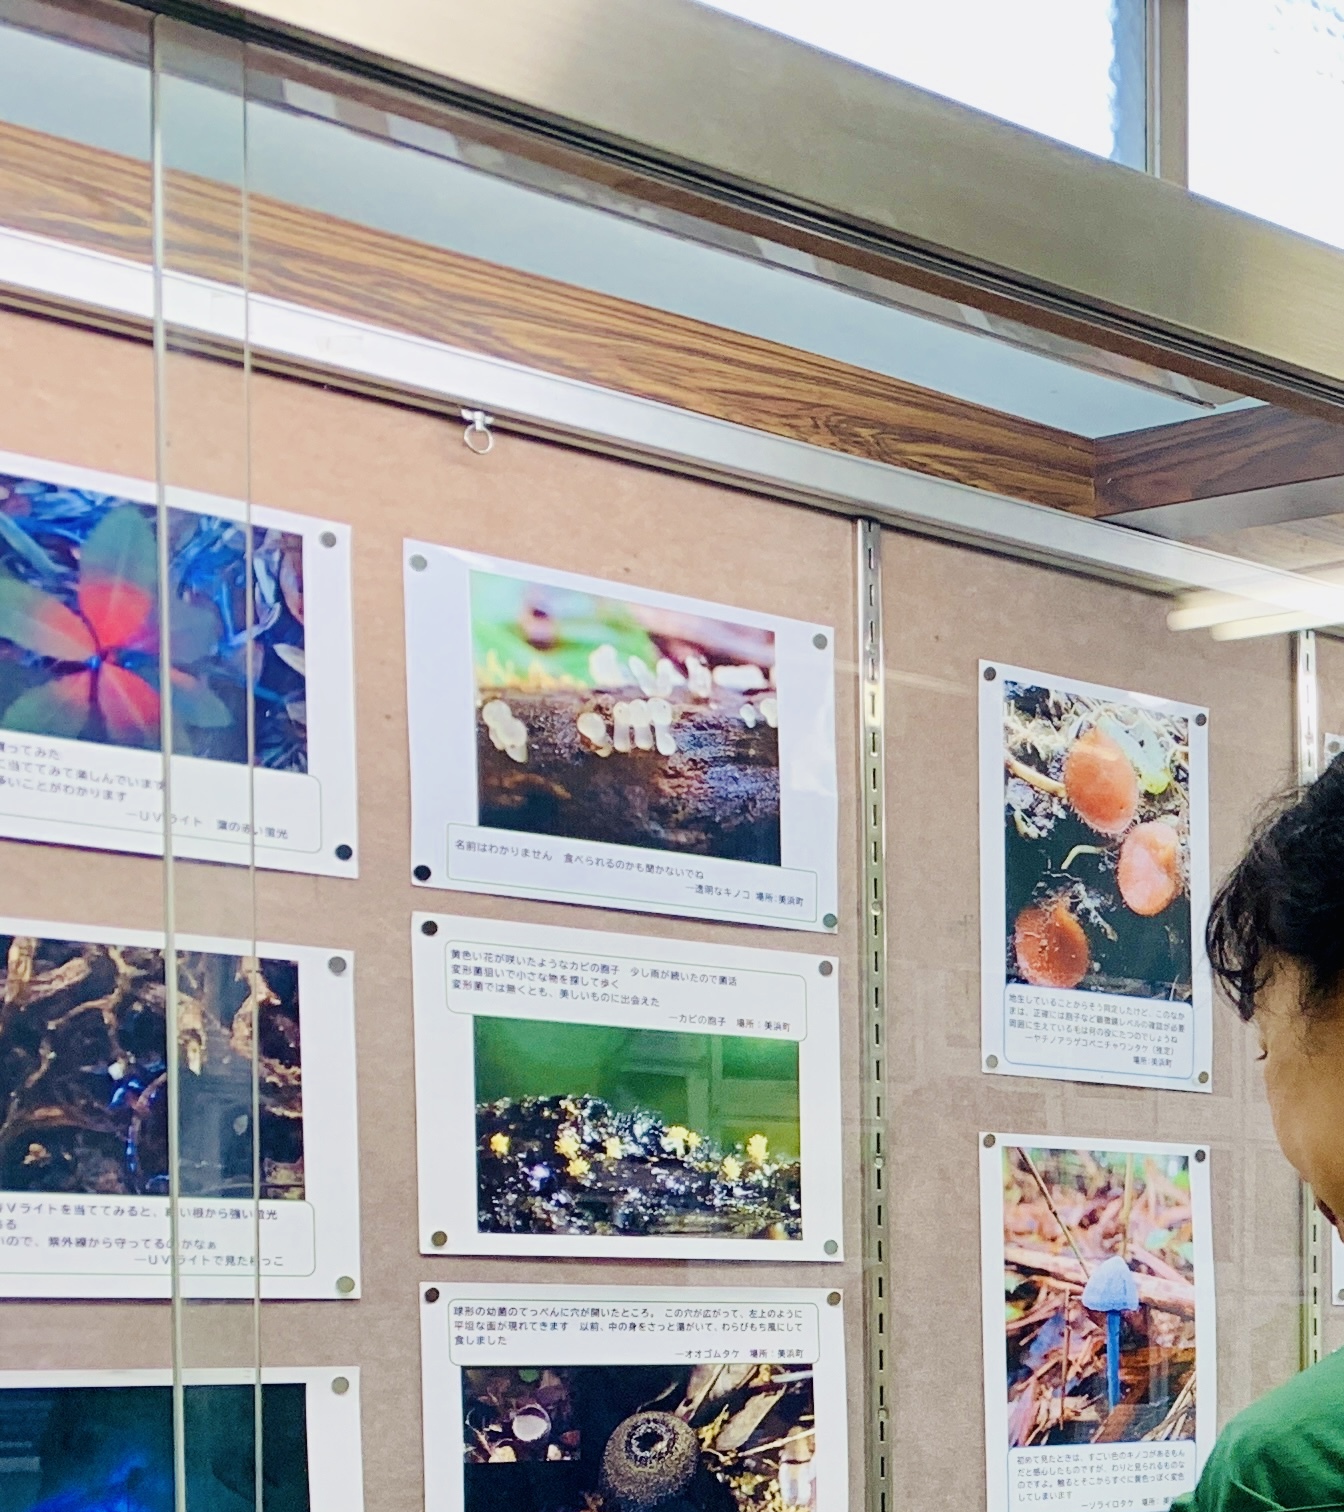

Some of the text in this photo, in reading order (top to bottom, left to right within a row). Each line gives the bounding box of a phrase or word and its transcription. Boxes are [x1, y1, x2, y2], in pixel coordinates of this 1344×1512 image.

[454, 839, 704, 880] 名前はわかりません 食べられるのかも聞かないでね
[451, 949, 737, 987] 黄色い花が咲いたようなカビの胞子 少し雨が続いたので菌活
[451, 964, 619, 988] 変形菌狙いで小さな物を探して歩く
[452, 979, 660, 1007] 変形菌では無くとも、美しいものに出会えた
[453, 1306, 802, 1319] 球形の幼菌のてっぺんに穴が開いたところ。 この穴が広がって、左上のように
[454, 1321, 569, 1331] 平坦な面が現れてきます
[454, 1335, 507, 1345] 食しました
[1017, 1449, 1185, 1465] 初めて見たときは、すごい色のキノコがあるもん
[1017, 1461, 1185, 1477] だと感心したものですが、わりと見られるものな
[1018, 1491, 1072, 1502] してしまいます
